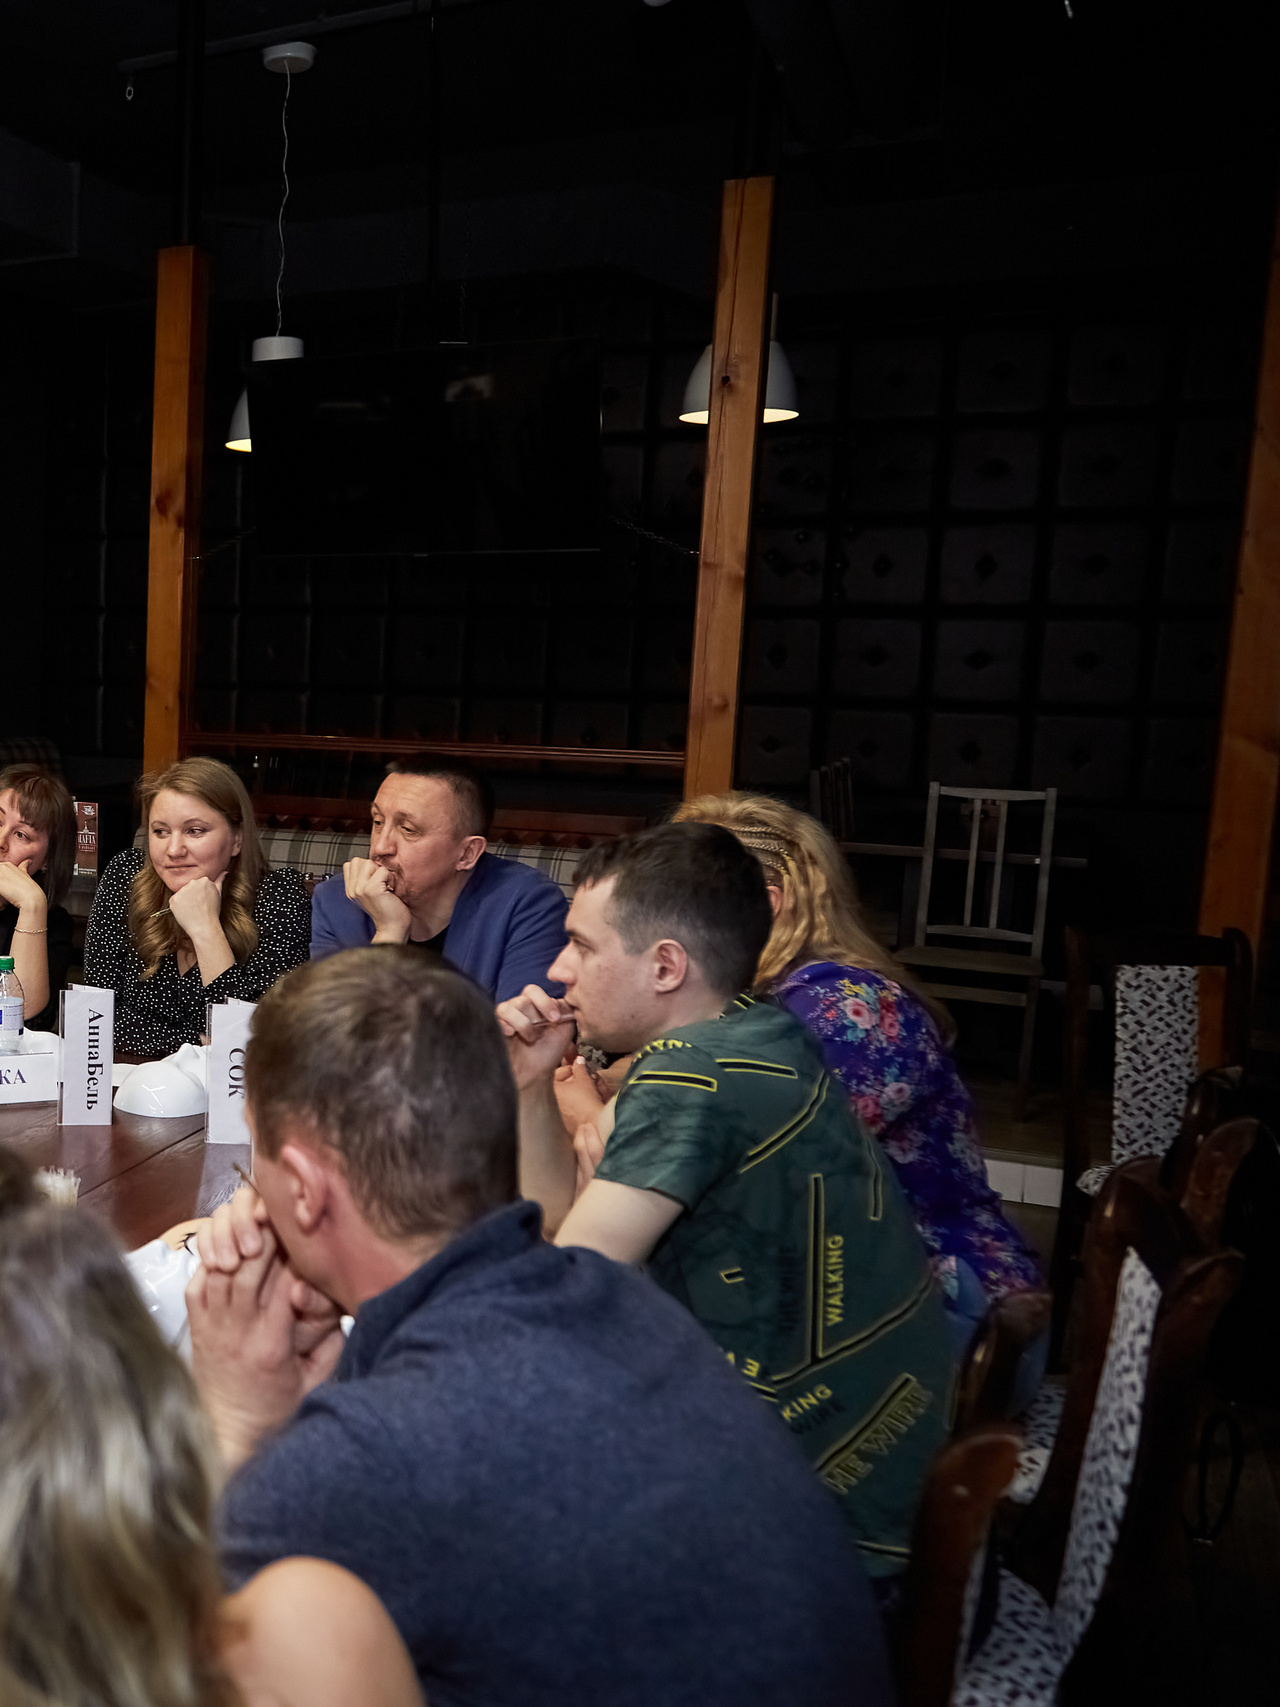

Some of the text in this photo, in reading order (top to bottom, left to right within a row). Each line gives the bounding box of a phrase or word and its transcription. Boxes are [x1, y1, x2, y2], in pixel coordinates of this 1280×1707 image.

[86, 1008, 105, 1111] АннаБель
[228, 1047, 246, 1100] СОК
[826, 1234, 844, 1327] WALKING
